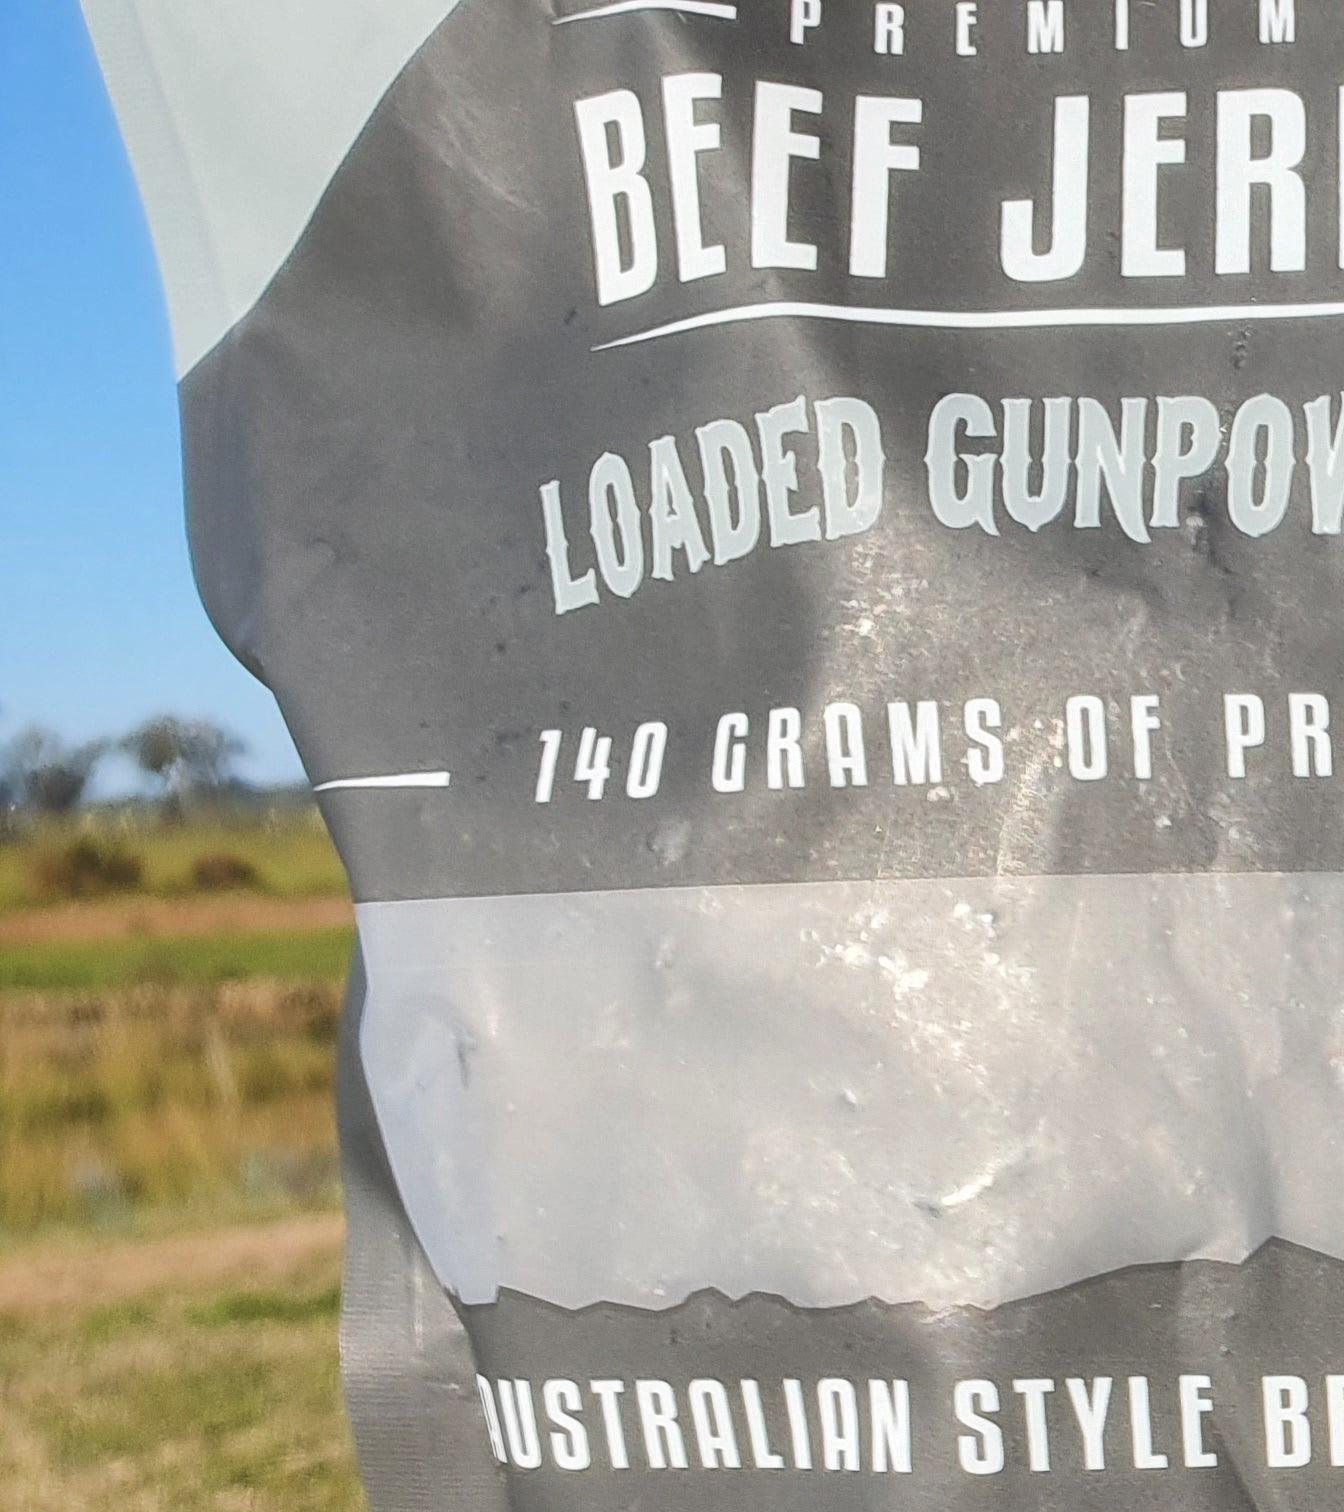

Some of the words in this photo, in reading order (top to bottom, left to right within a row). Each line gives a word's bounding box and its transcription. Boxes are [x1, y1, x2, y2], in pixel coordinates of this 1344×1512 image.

[790, 0, 1296, 56] PREMIUM
[572, 72, 924, 306] BEEF
[538, 395, 886, 616] LOADED
[535, 721, 668, 803] 140
[711, 698, 1005, 792] GRAMS
[1066, 694, 1163, 780] OF
[476, 1373, 913, 1474] AUSTRALIAN
[952, 1373, 1218, 1475] STYLE
